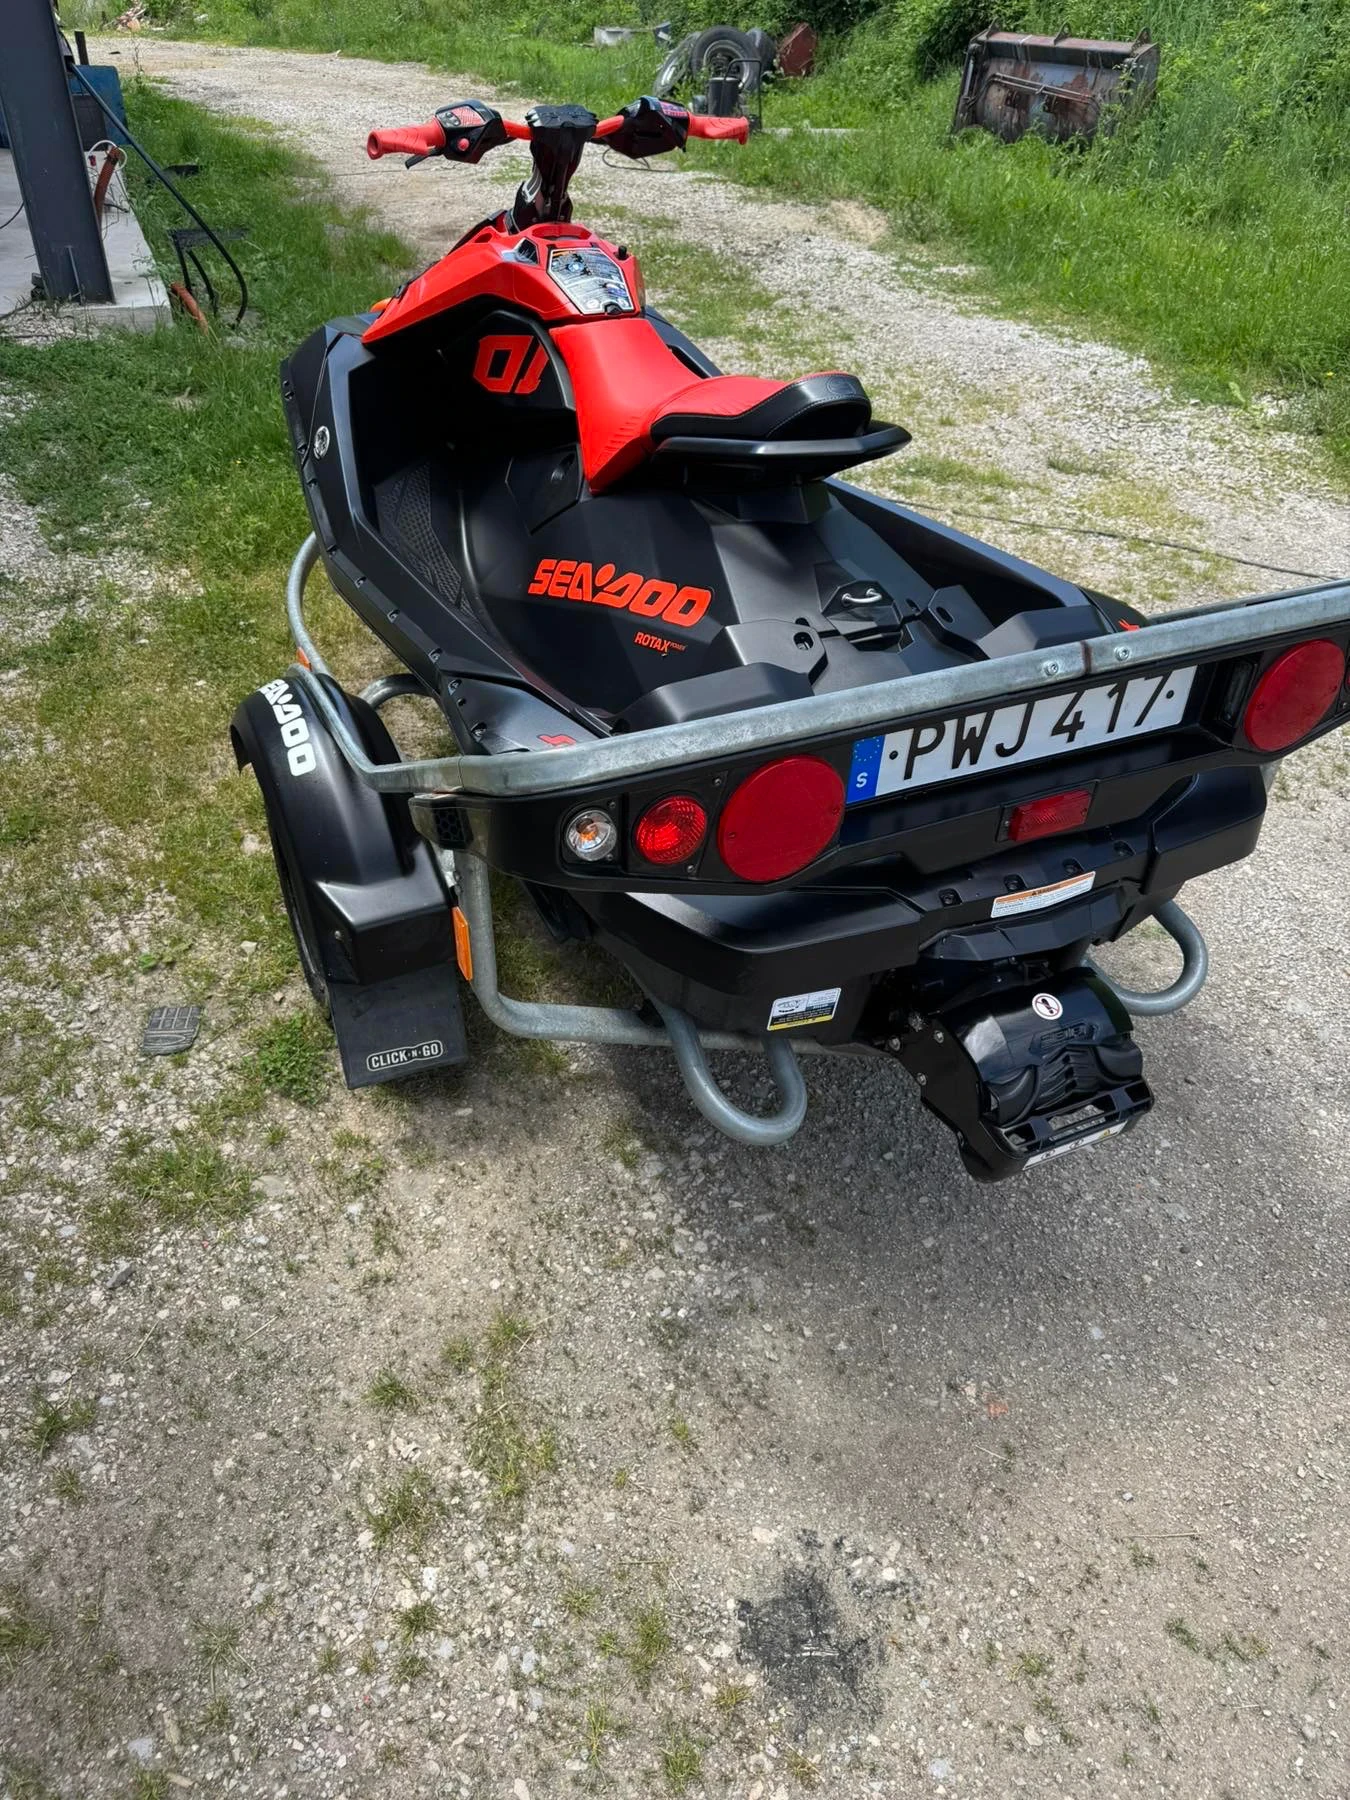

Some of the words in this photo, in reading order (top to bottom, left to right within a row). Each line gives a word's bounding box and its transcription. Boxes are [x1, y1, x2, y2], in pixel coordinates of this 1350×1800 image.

[635, 631, 670, 652] ROTAX
[902, 702, 1034, 781] PWJ
[1050, 671, 1172, 743] 417
[856, 772, 868, 788] S
